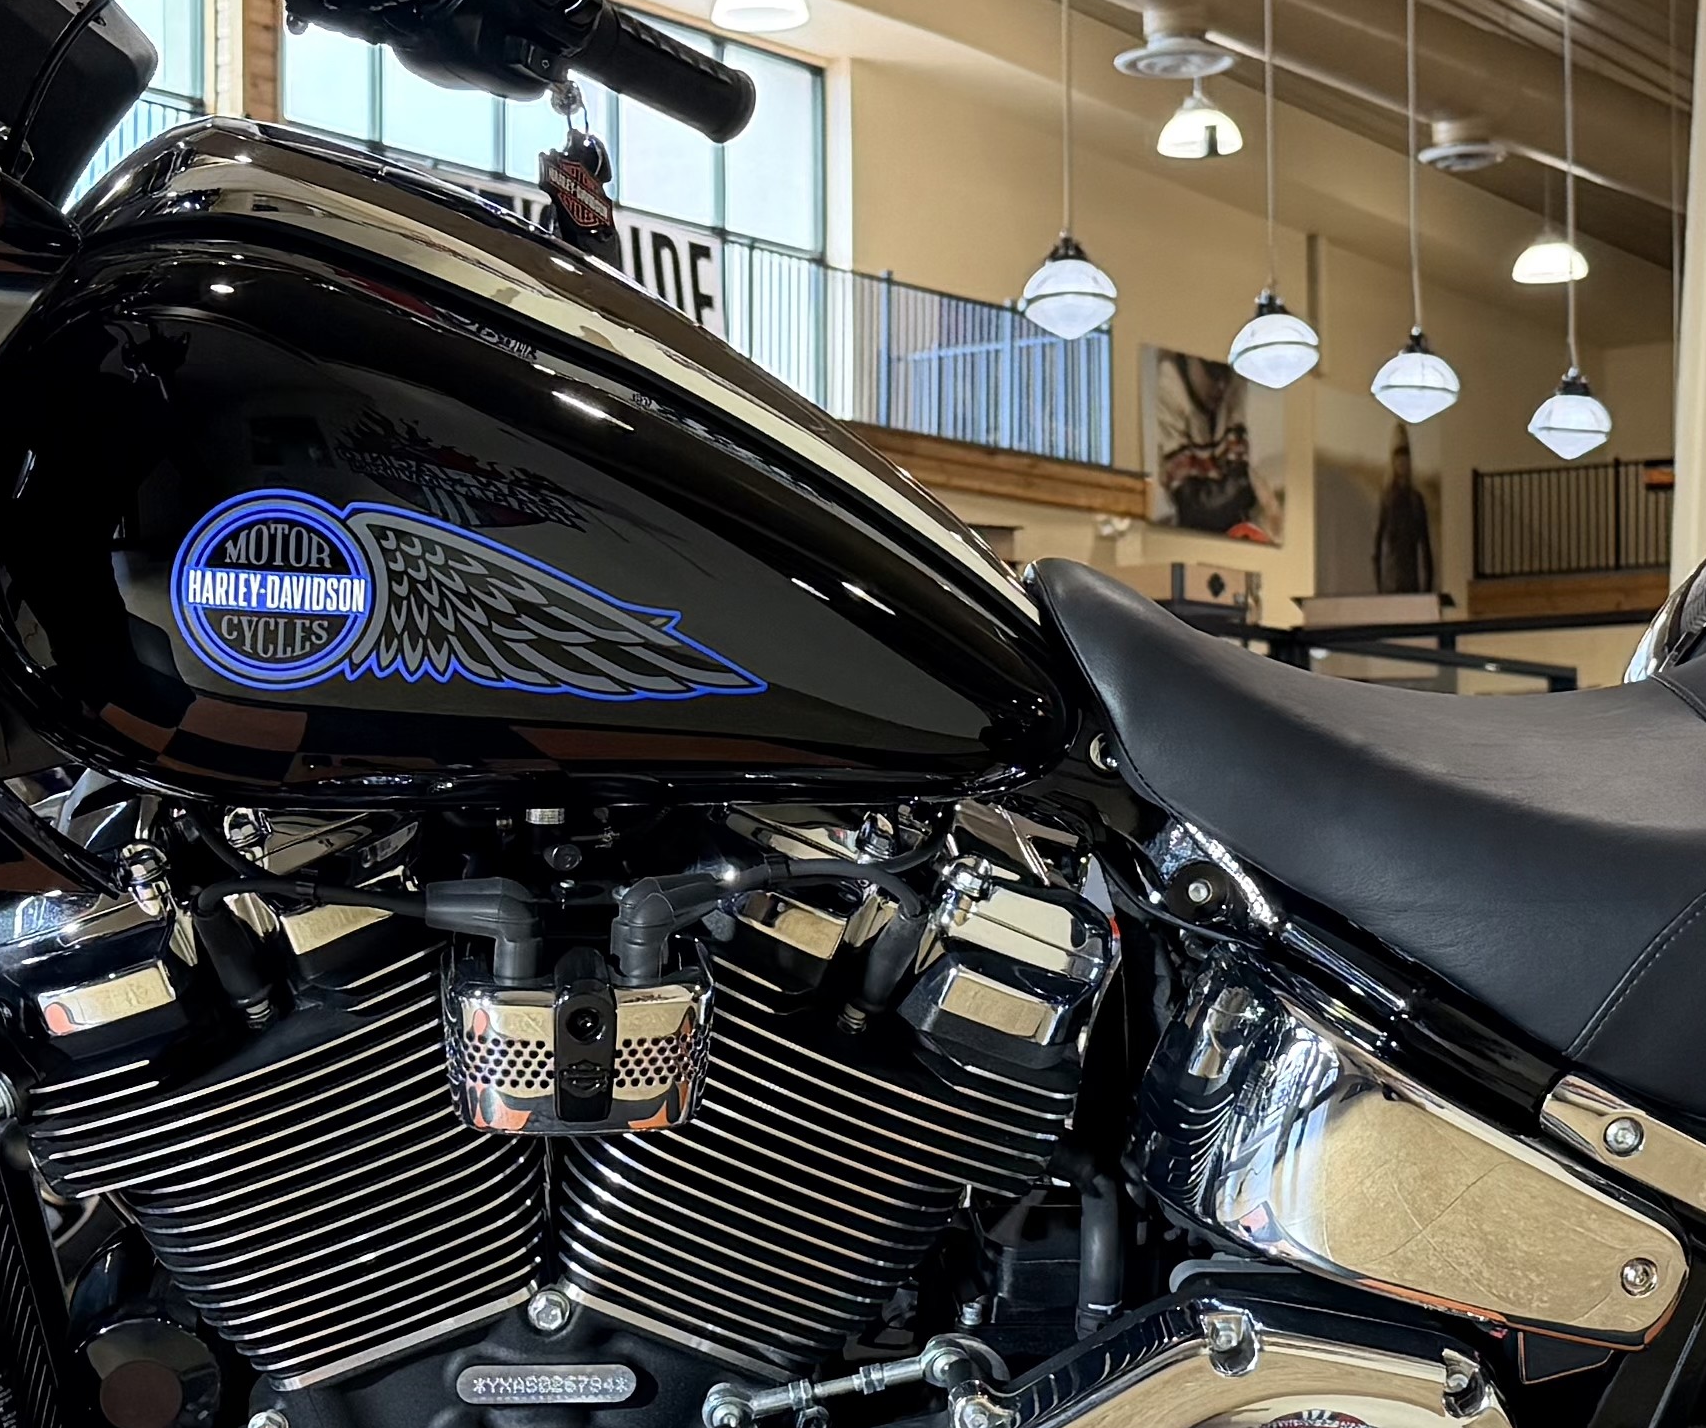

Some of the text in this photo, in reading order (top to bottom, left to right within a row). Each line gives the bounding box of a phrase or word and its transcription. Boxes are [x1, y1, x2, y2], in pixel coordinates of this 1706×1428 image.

[224, 523, 333, 568] MOTOR
[188, 569, 366, 614] HARLEY-DAVIDSON
[220, 614, 329, 659] CYCLES
